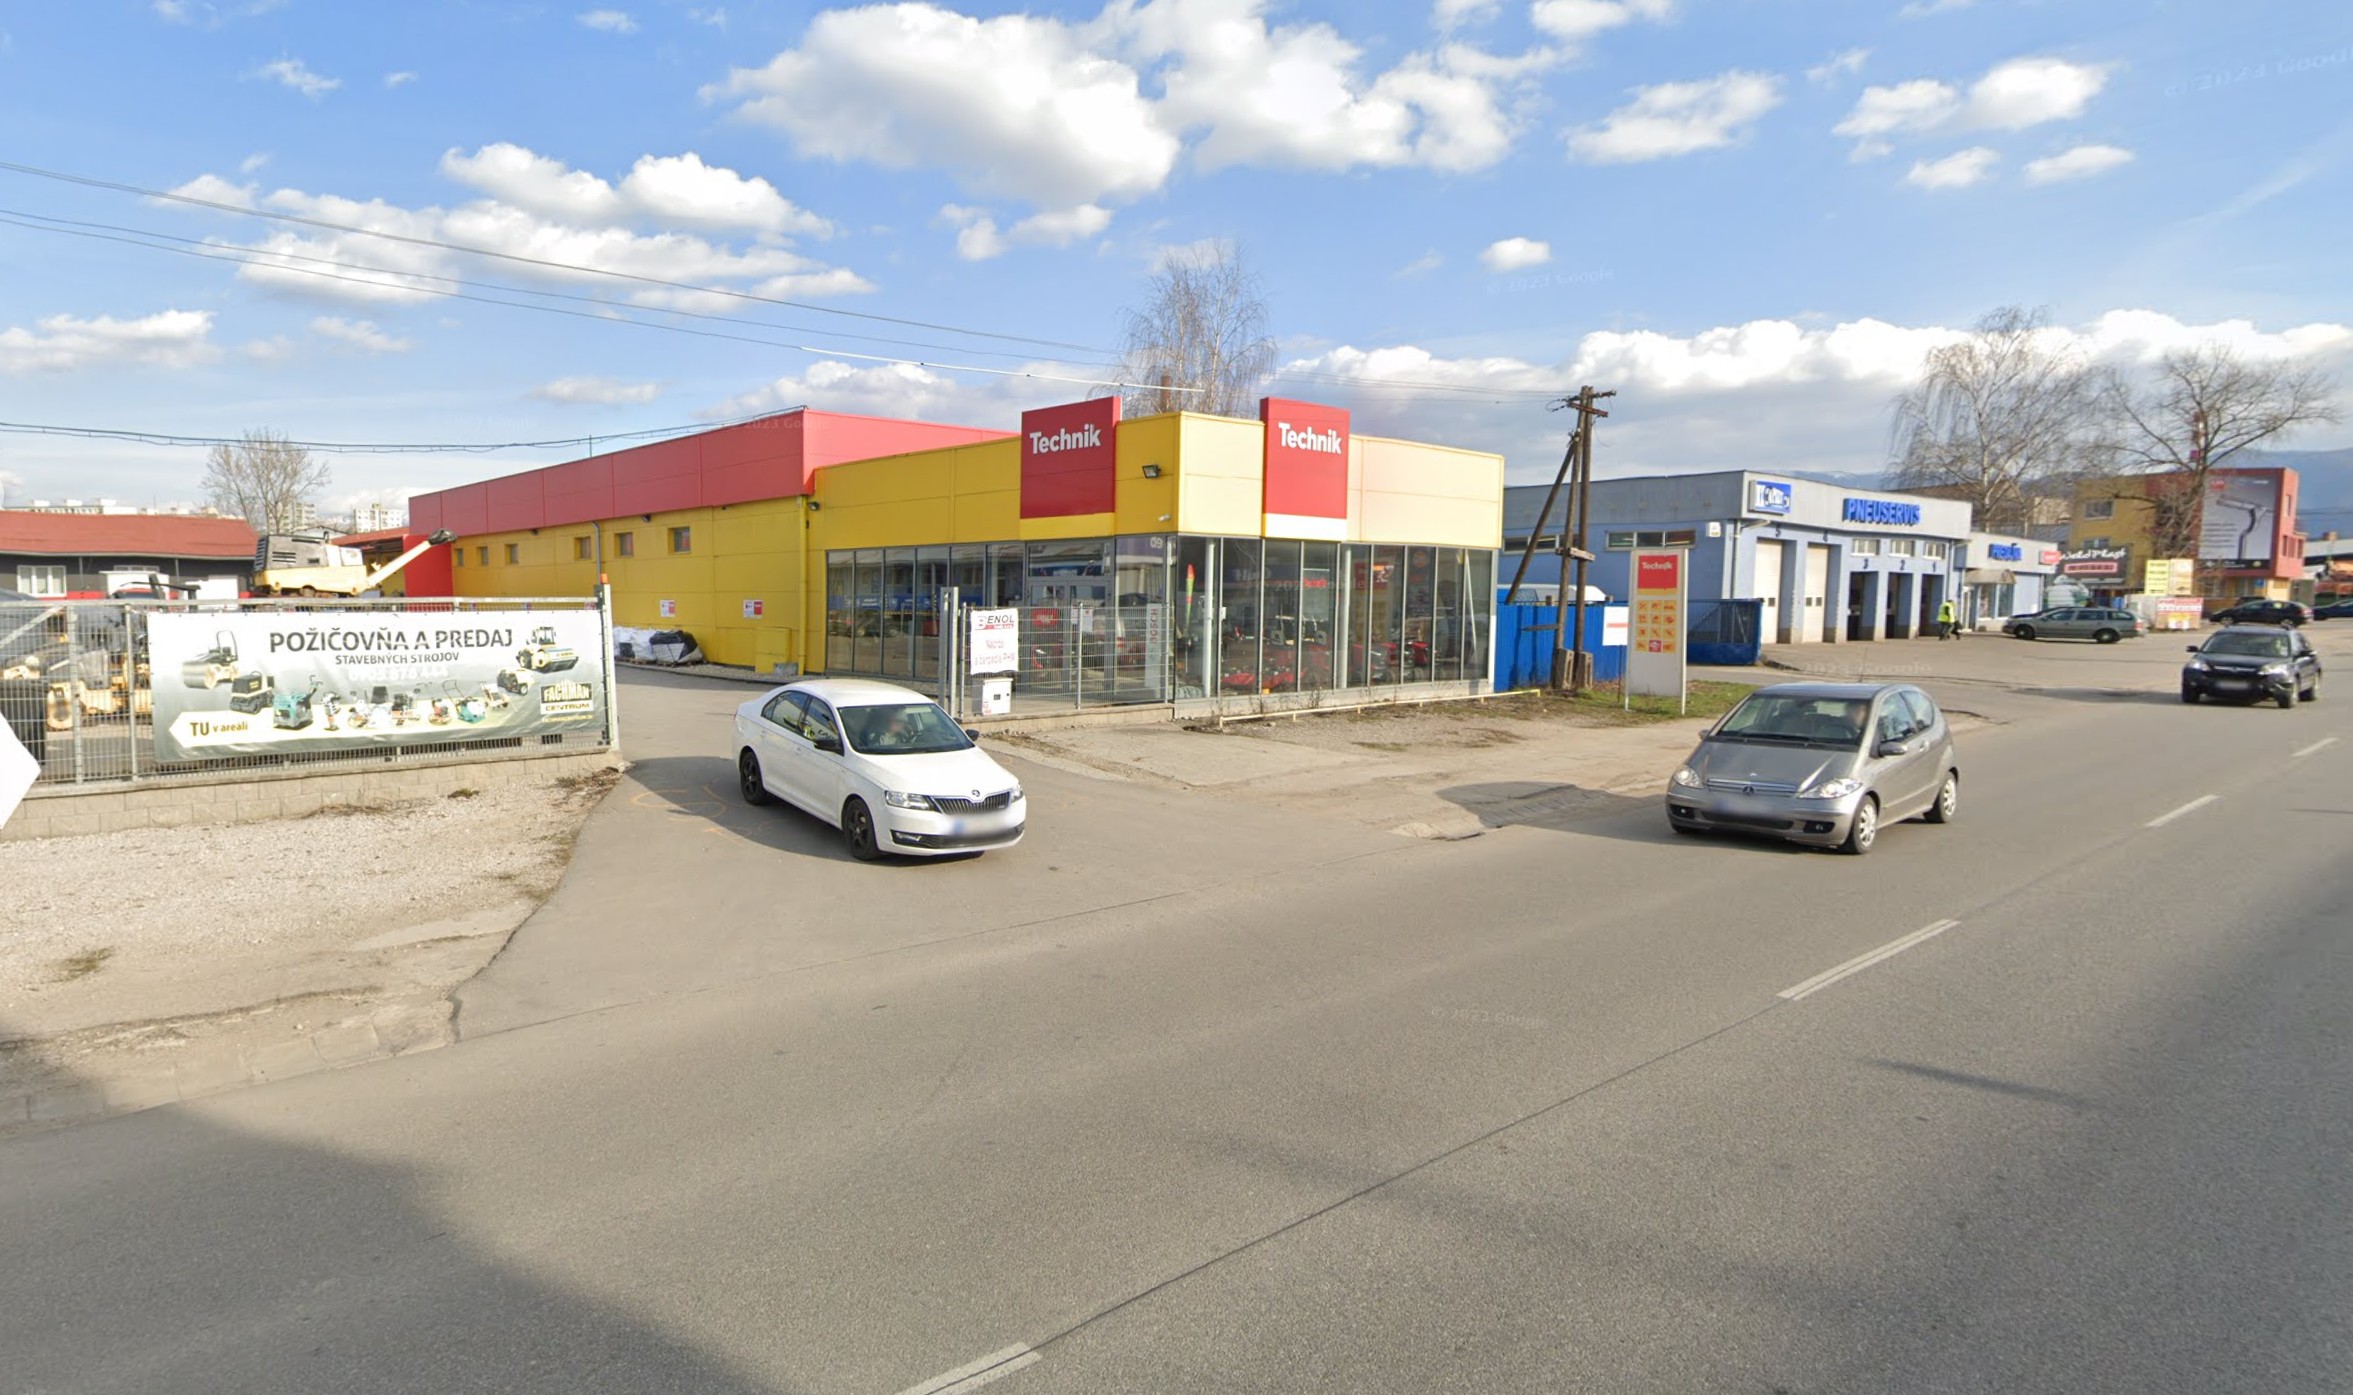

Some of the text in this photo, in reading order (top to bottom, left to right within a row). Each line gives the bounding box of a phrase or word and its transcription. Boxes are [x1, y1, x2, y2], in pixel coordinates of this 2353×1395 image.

[1030, 424, 1102, 455] Technik
[1278, 422, 1342, 455] Technik
[1844, 498, 1921, 526] PNEUSERVIS
[1641, 561, 1673, 570] Technik
[1149, 608, 1159, 644] BOSCH
[269, 627, 513, 653] POŽIČOVŇA A PREDAJ
[335, 651, 460, 665] STAVEBNÝCH STROJOV
[190, 722, 210, 736] TU
